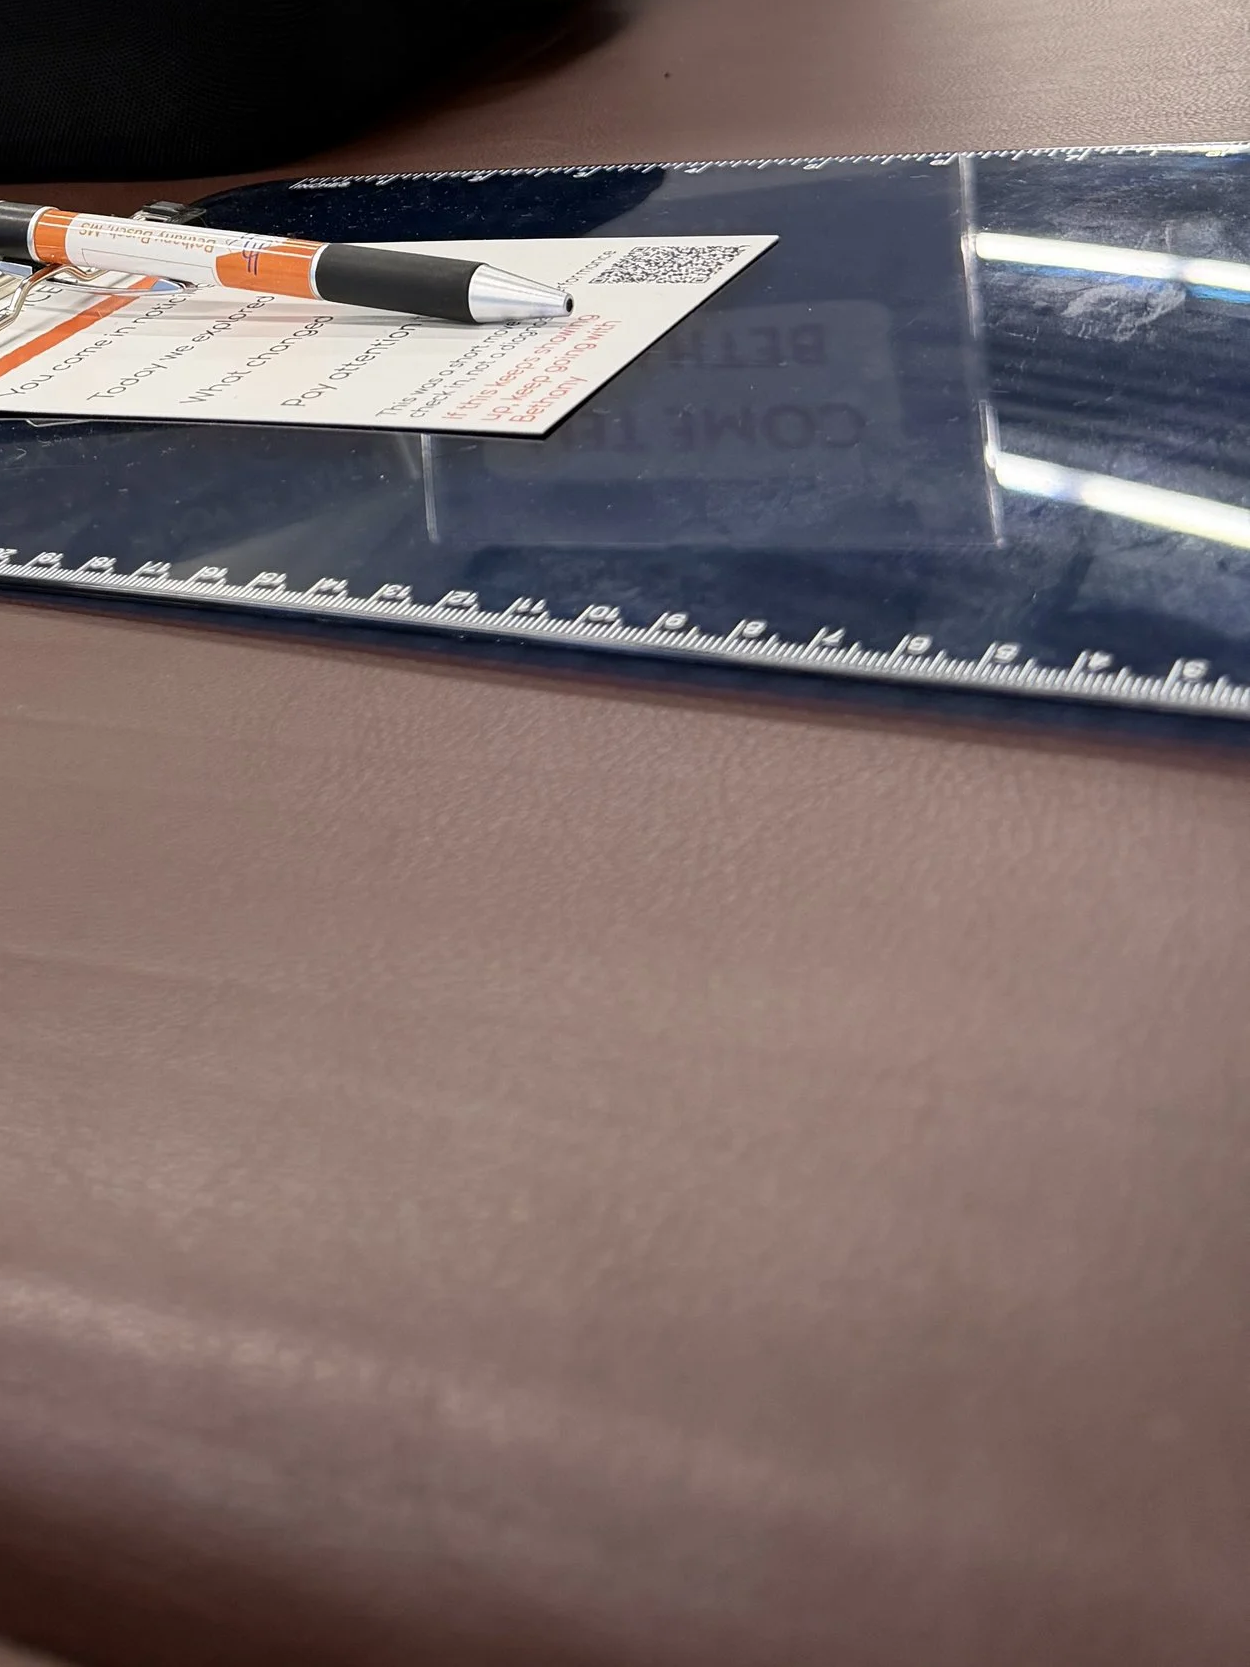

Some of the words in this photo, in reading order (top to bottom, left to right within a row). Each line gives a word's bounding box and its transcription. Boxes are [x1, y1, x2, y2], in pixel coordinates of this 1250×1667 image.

[555, 250, 617, 293] rformance
[0, 374, 55, 399] You
[53, 339, 113, 371] came
[104, 326, 136, 337] in
[86, 363, 168, 401] Today
[165, 344, 195, 361] we
[192, 295, 275, 344] explored
[180, 369, 252, 404] What
[246, 315, 334, 369] changed
[281, 383, 338, 407] Pay
[329, 322, 423, 381] attention
[375, 395, 417, 417] This
[415, 377, 444, 396] was
[439, 369, 454, 377] a
[449, 343, 490, 369] short
[483, 319, 521, 345] move
[409, 390, 457, 418] check
[451, 376, 476, 390] in,
[467, 359, 491, 378] not
[490, 352, 507, 360] a
[501, 316, 555, 351] diagno
[442, 411, 468, 420] If
[457, 383, 499, 411] this
[492, 356, 541, 387] keeps
[534, 313, 601, 356] showing
[481, 402, 520, 421] up,
[509, 374, 552, 401] keep
[544, 342, 598, 374] going
[583, 319, 623, 344] with
[508, 374, 589, 424] Bethany
[590, 605, 621, 622] 10
